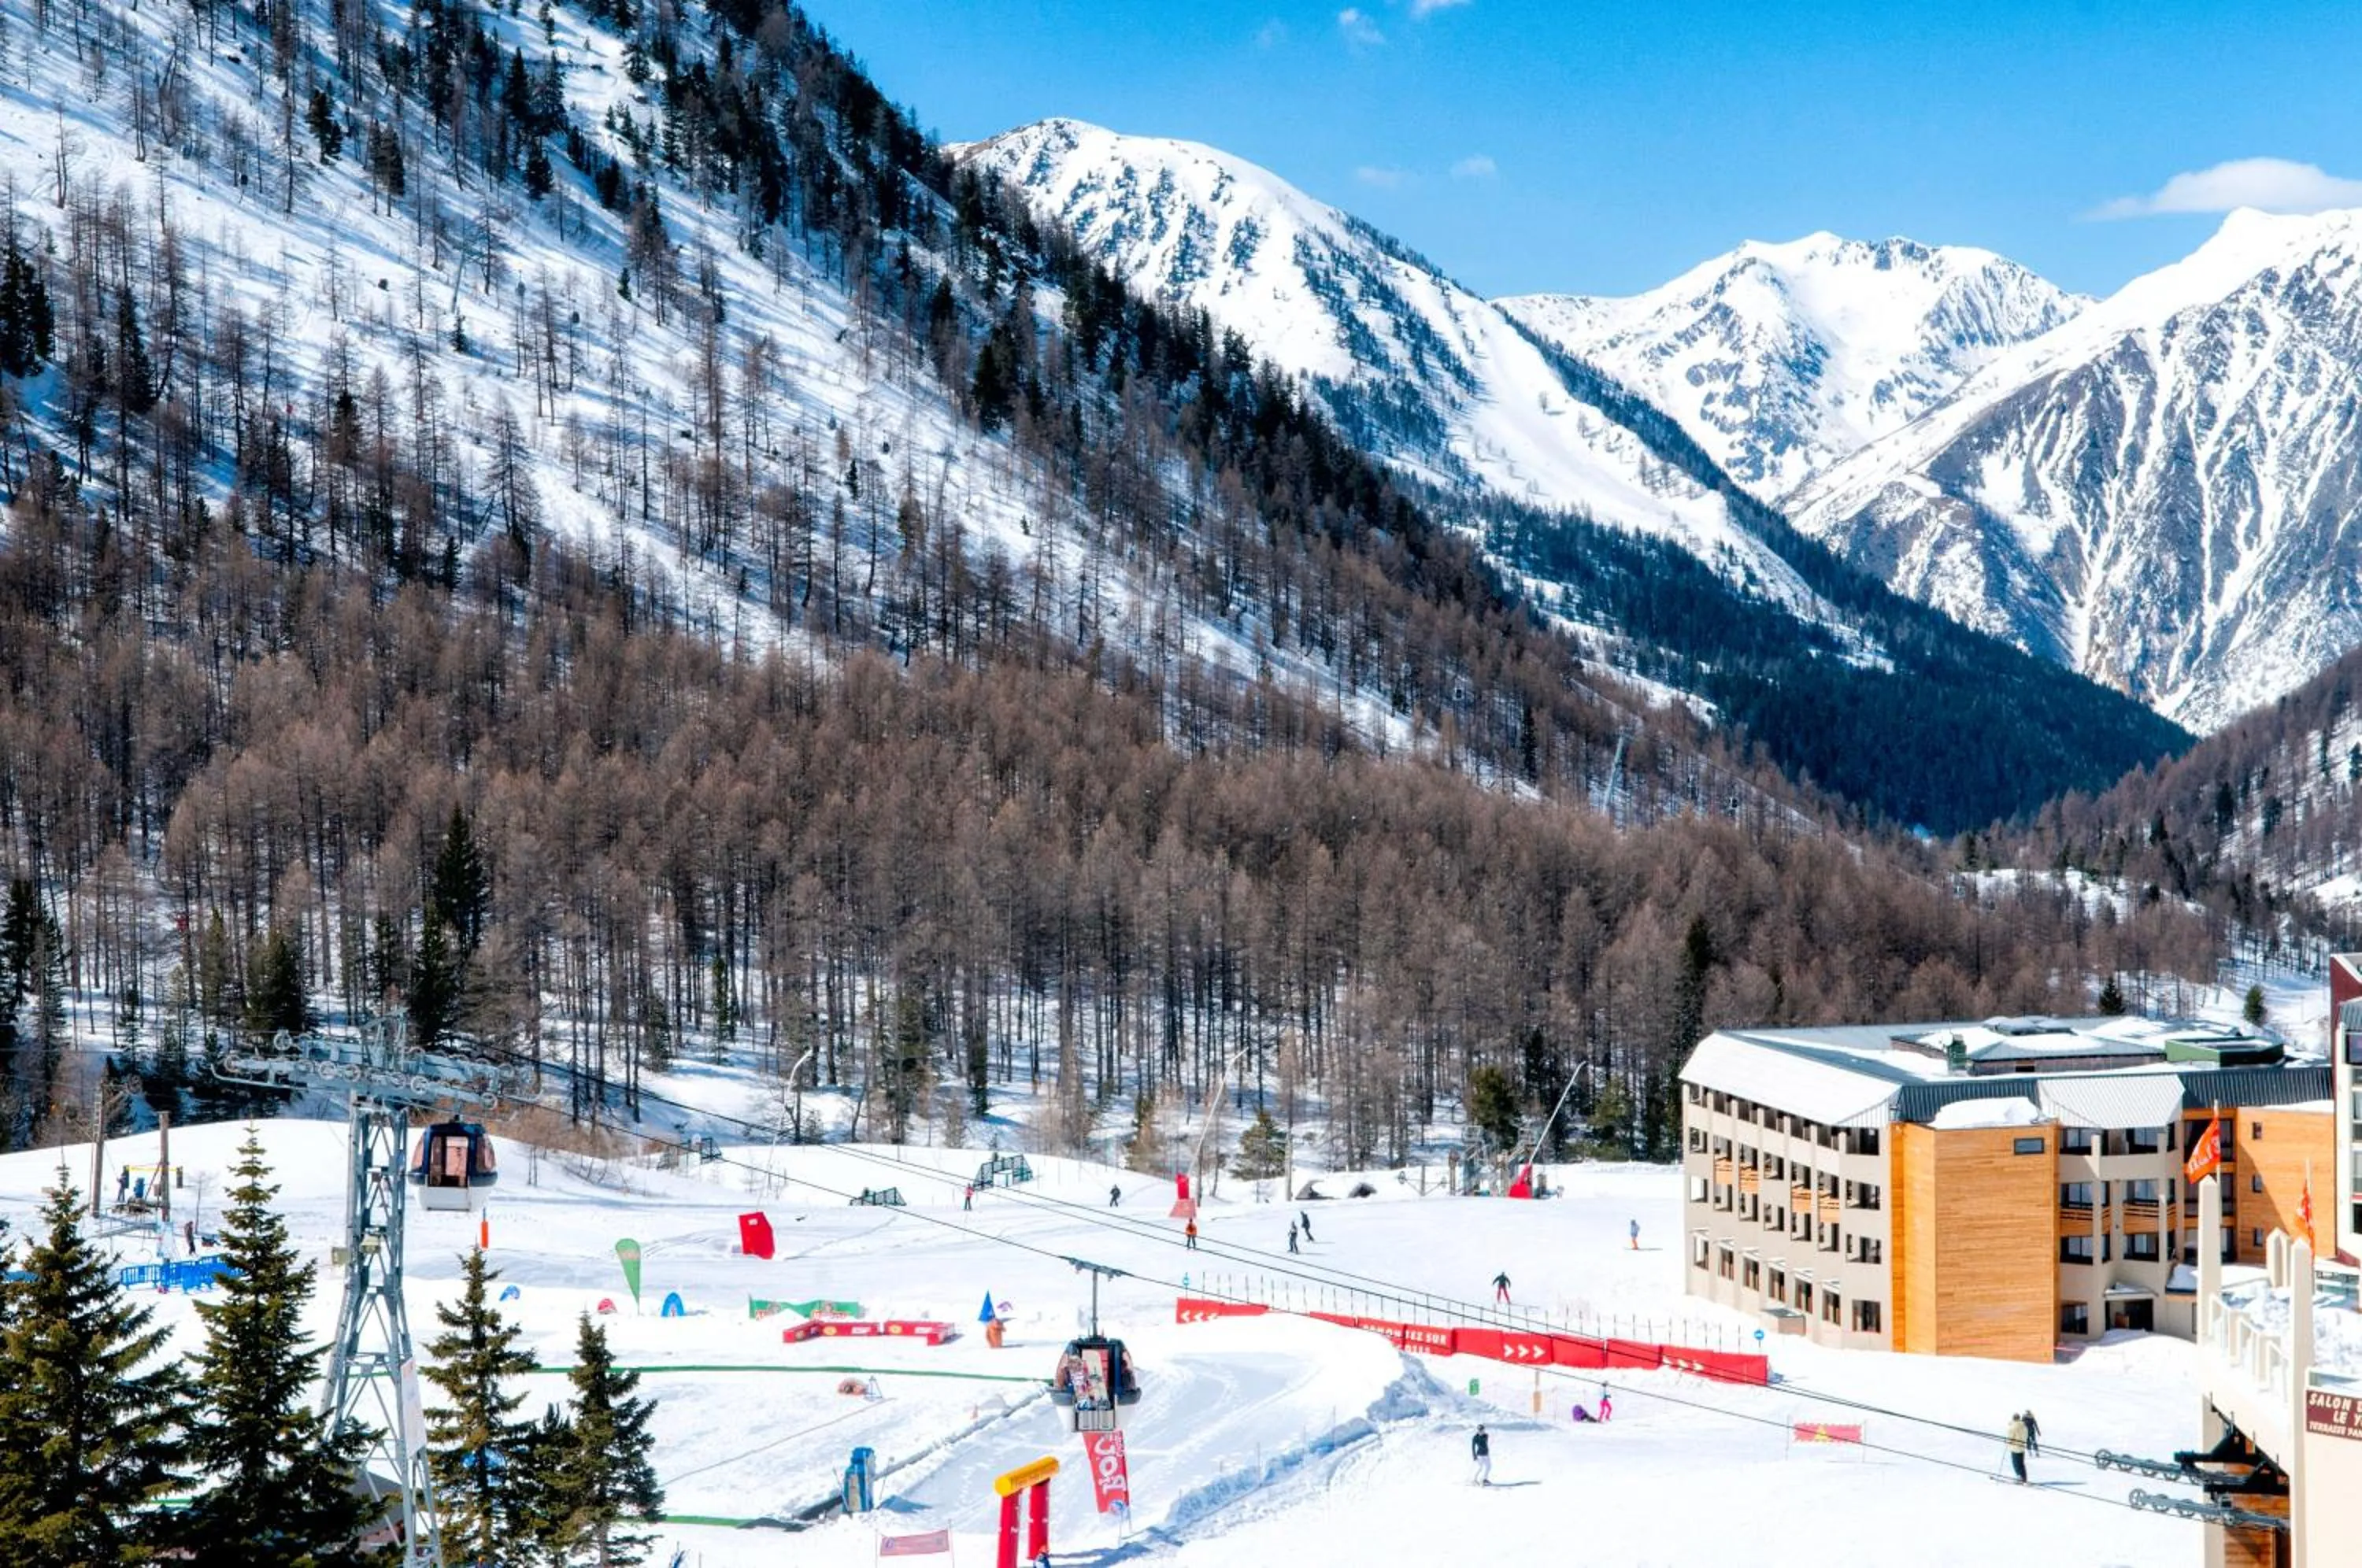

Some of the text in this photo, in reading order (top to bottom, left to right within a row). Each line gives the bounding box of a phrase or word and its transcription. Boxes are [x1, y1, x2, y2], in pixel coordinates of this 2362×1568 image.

[1426, 1332, 1446, 1346] SUR
[2308, 1392, 2352, 1411] SALON
[2333, 1410, 2348, 1424] LE
[2309, 1421, 2346, 1435] TERRASSE
